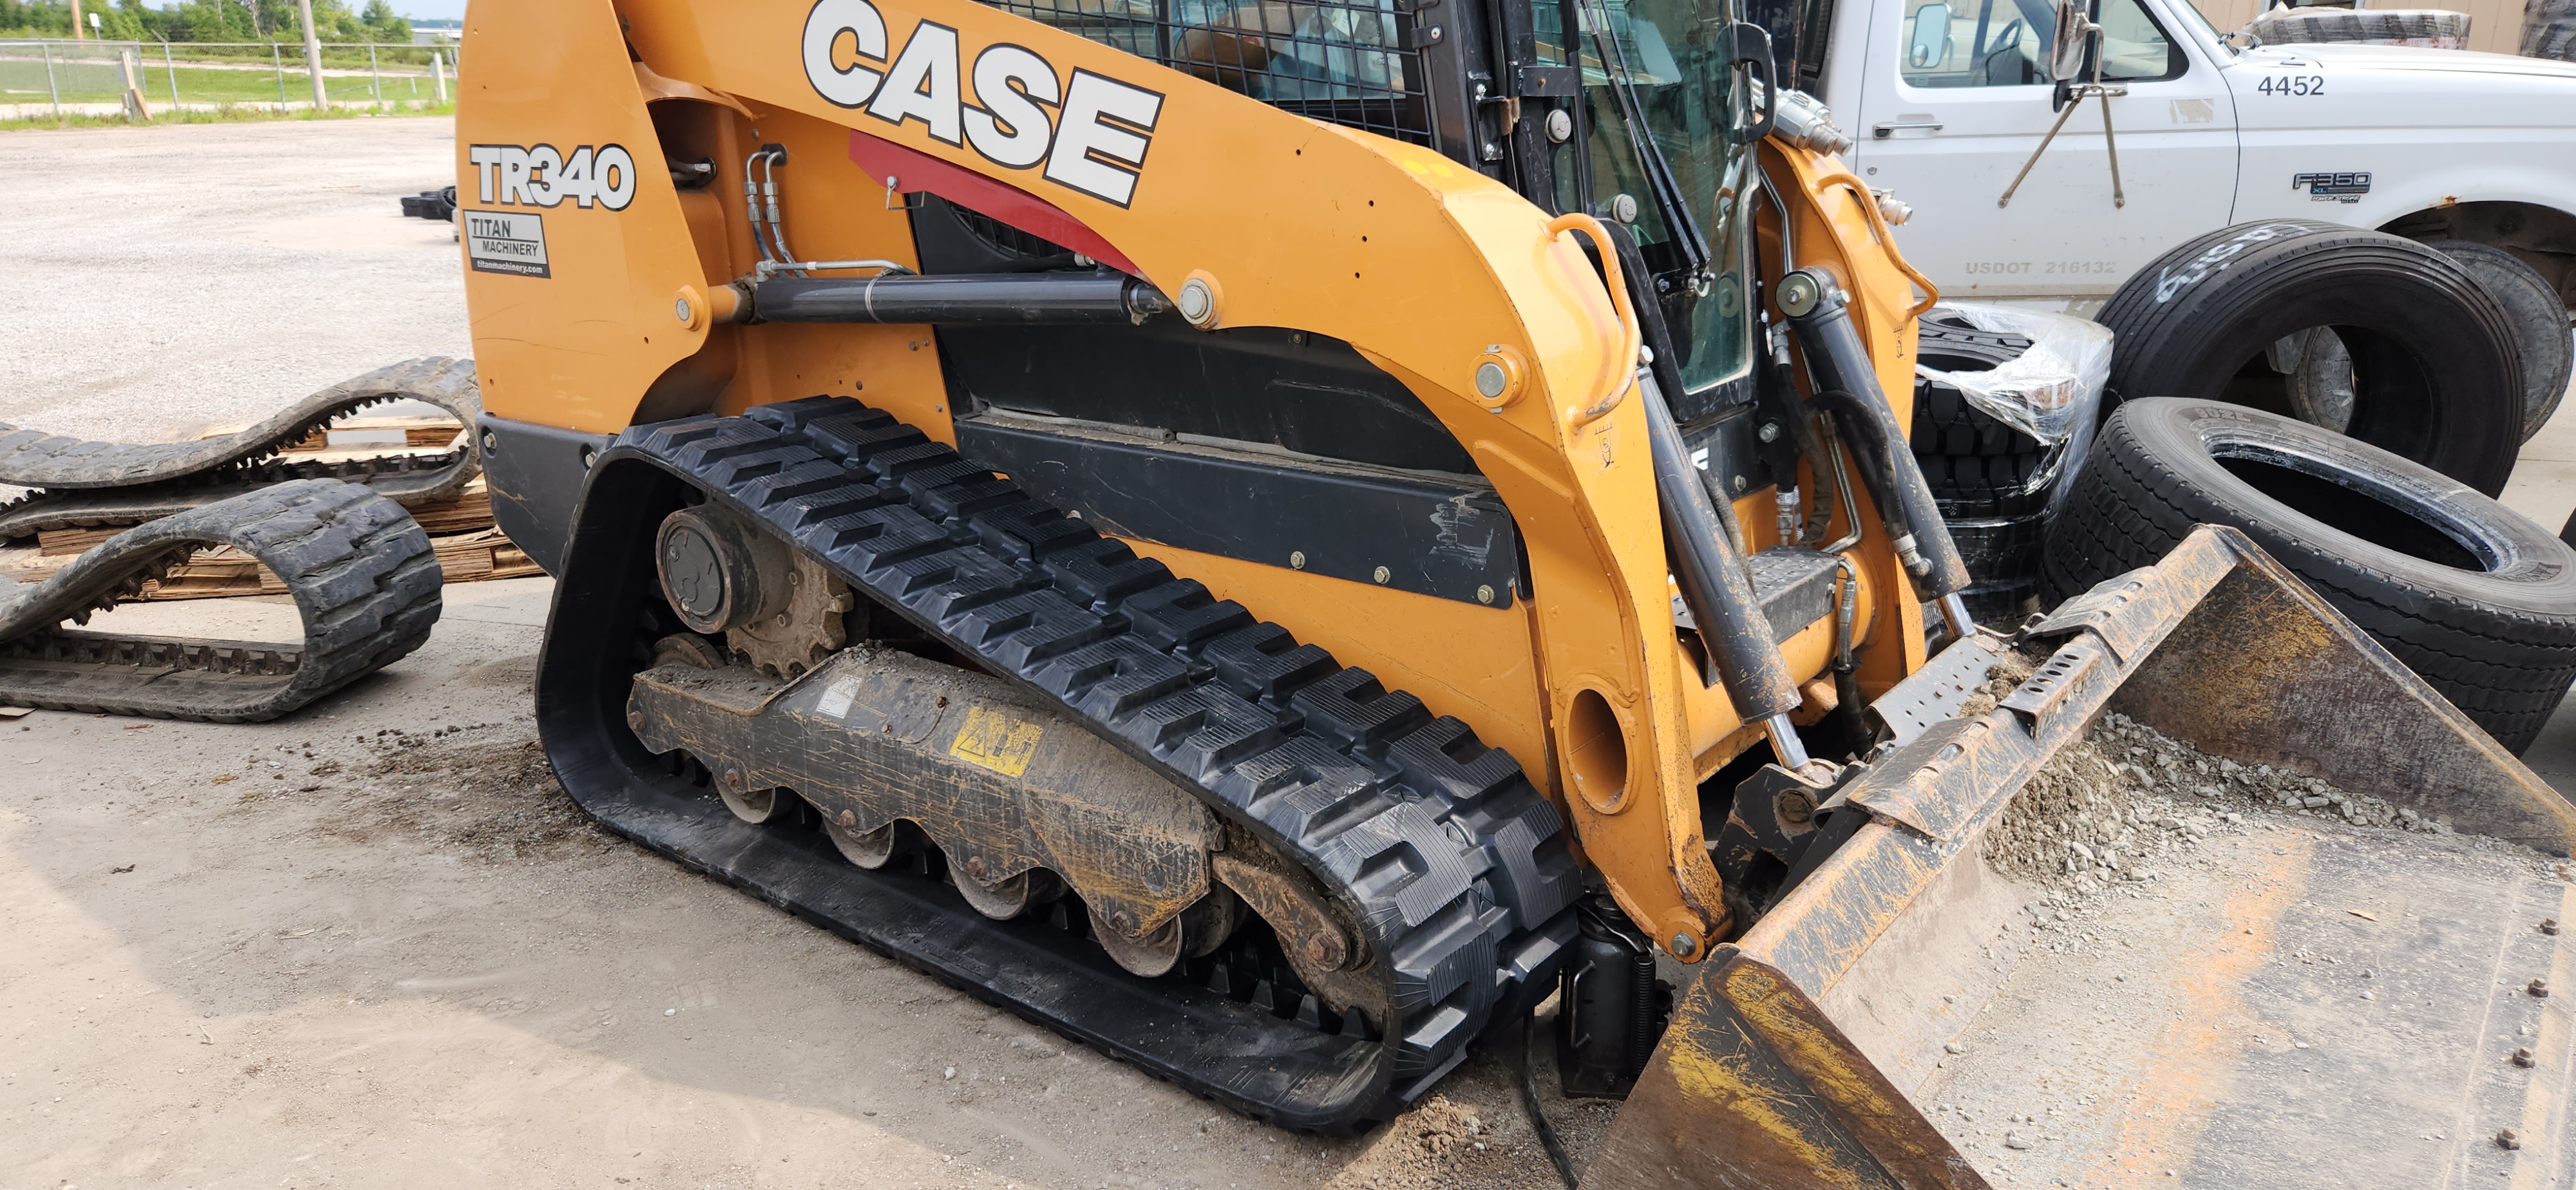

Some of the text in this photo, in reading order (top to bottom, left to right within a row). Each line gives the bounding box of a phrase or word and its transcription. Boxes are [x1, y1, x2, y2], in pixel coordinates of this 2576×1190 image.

[2257, 75, 2324, 96] 4452
[802, 0, 1166, 211] CASE
[469, 143, 636, 212] TR340
[471, 218, 511, 238] TITAN
[482, 240, 538, 257] MACHINERY
[477, 259, 543, 274] titanmachinery.com
[1965, 261, 2117, 275] USDOT 216132
